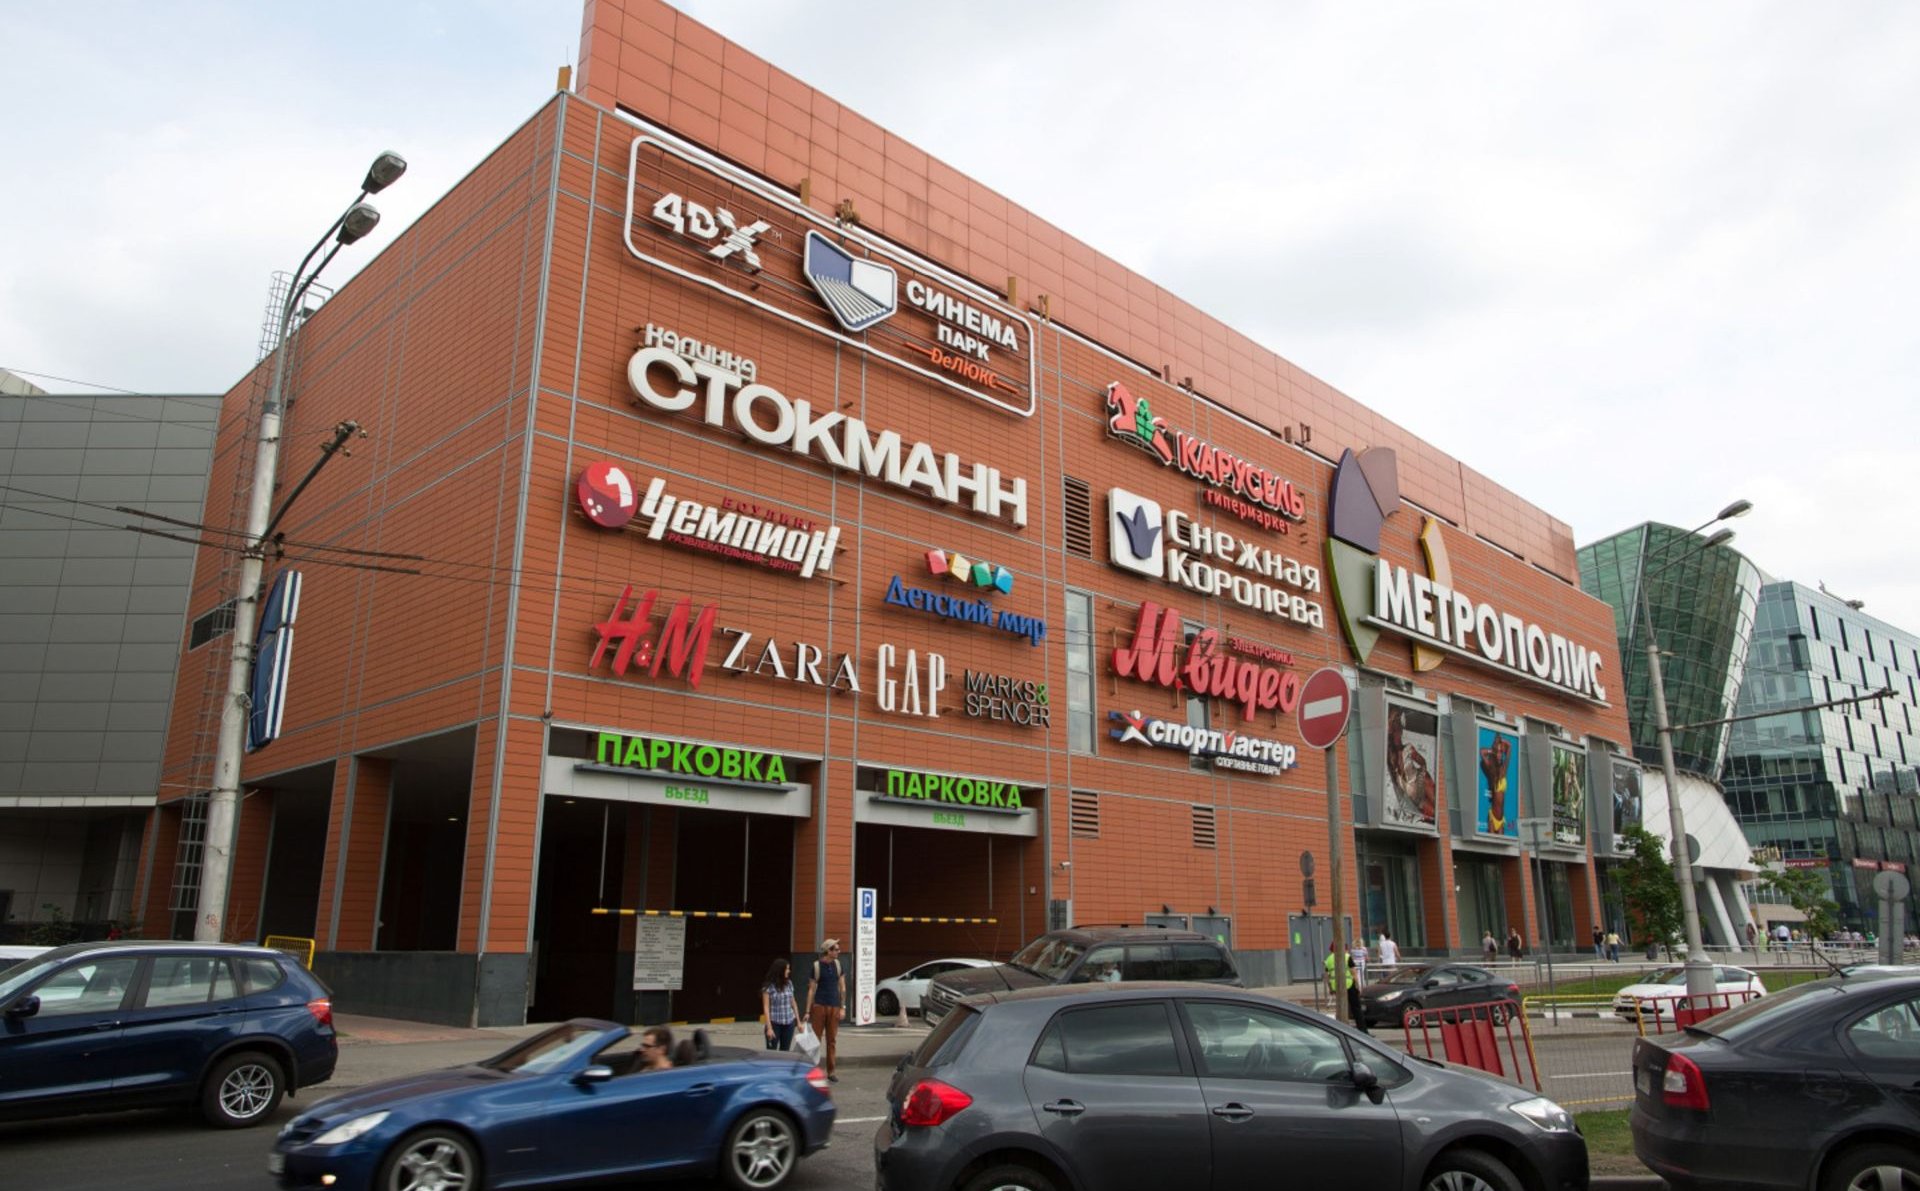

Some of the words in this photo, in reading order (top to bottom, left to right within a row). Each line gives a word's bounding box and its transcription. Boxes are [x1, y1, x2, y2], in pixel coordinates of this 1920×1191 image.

[652, 192, 772, 269] 4DX
[907, 279, 1019, 351] СИНЕМА
[937, 321, 991, 363] ПАРК
[627, 346, 1029, 528] СТОКМАНН
[1176, 431, 1307, 520] КАРУСЕЛЬ
[1203, 488, 1293, 535] гипермаркет
[638, 477, 841, 579] Чемпион
[1166, 508, 1322, 594] Снежная
[884, 573, 993, 627] Детский
[997, 609, 1048, 647] мир
[1167, 548, 1325, 630] Королева
[588, 584, 719, 691] H&M
[720, 626, 864, 694] ZARA
[1230, 636, 1297, 667] ЭЛЕКТРОНИКА
[1374, 559, 1606, 701] МЕТРОПОЛИС
[876, 642, 949, 719] GAP
[963, 694, 1052, 729] SPENCER
[596, 732, 788, 784] ПАРКОВКА
[664, 785, 710, 805] ВЪЕЗД
[887, 769, 1023, 809] ПАРКОВКА
